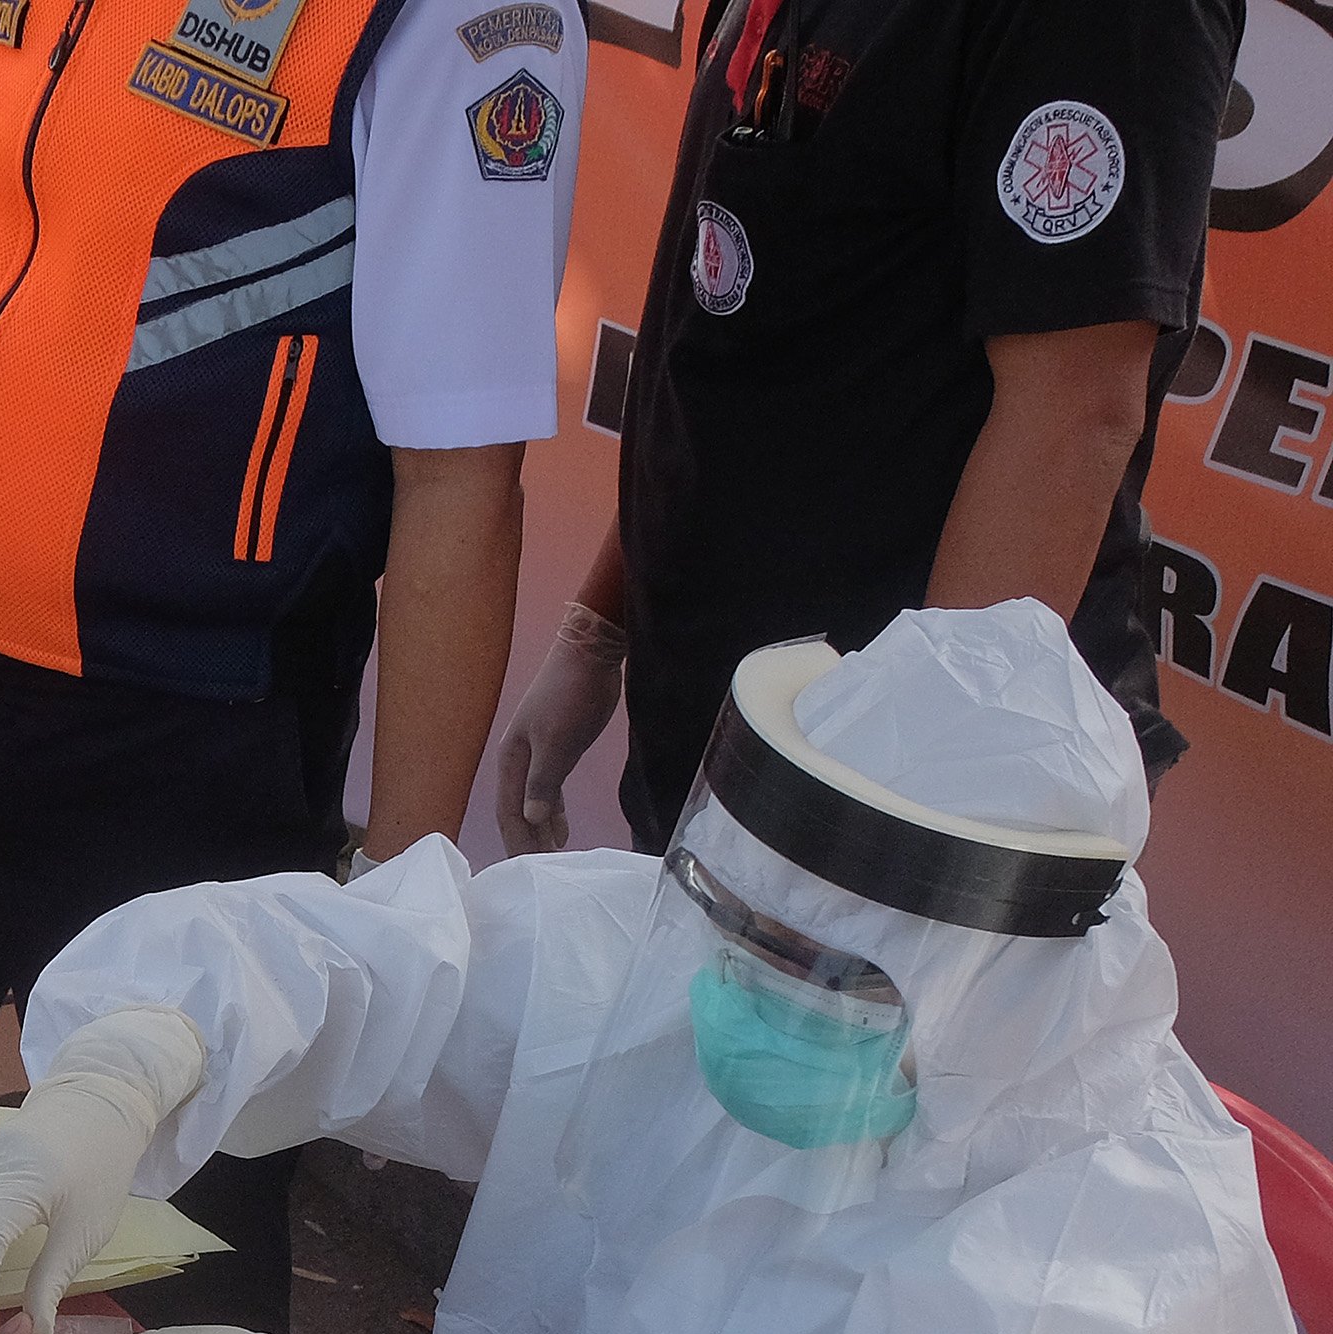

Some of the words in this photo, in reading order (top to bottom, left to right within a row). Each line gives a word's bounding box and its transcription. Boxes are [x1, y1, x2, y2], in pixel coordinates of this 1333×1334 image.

[178, 11, 271, 73] DISHUB
[136, 53, 190, 100] KABID
[189, 78, 269, 135] DALOPS
[1052, 109, 1094, 127] RESCUE
[1092, 120, 1113, 146] TASK
[1107, 145, 1121, 180] FORCE
[1043, 217, 1077, 232] QRV
